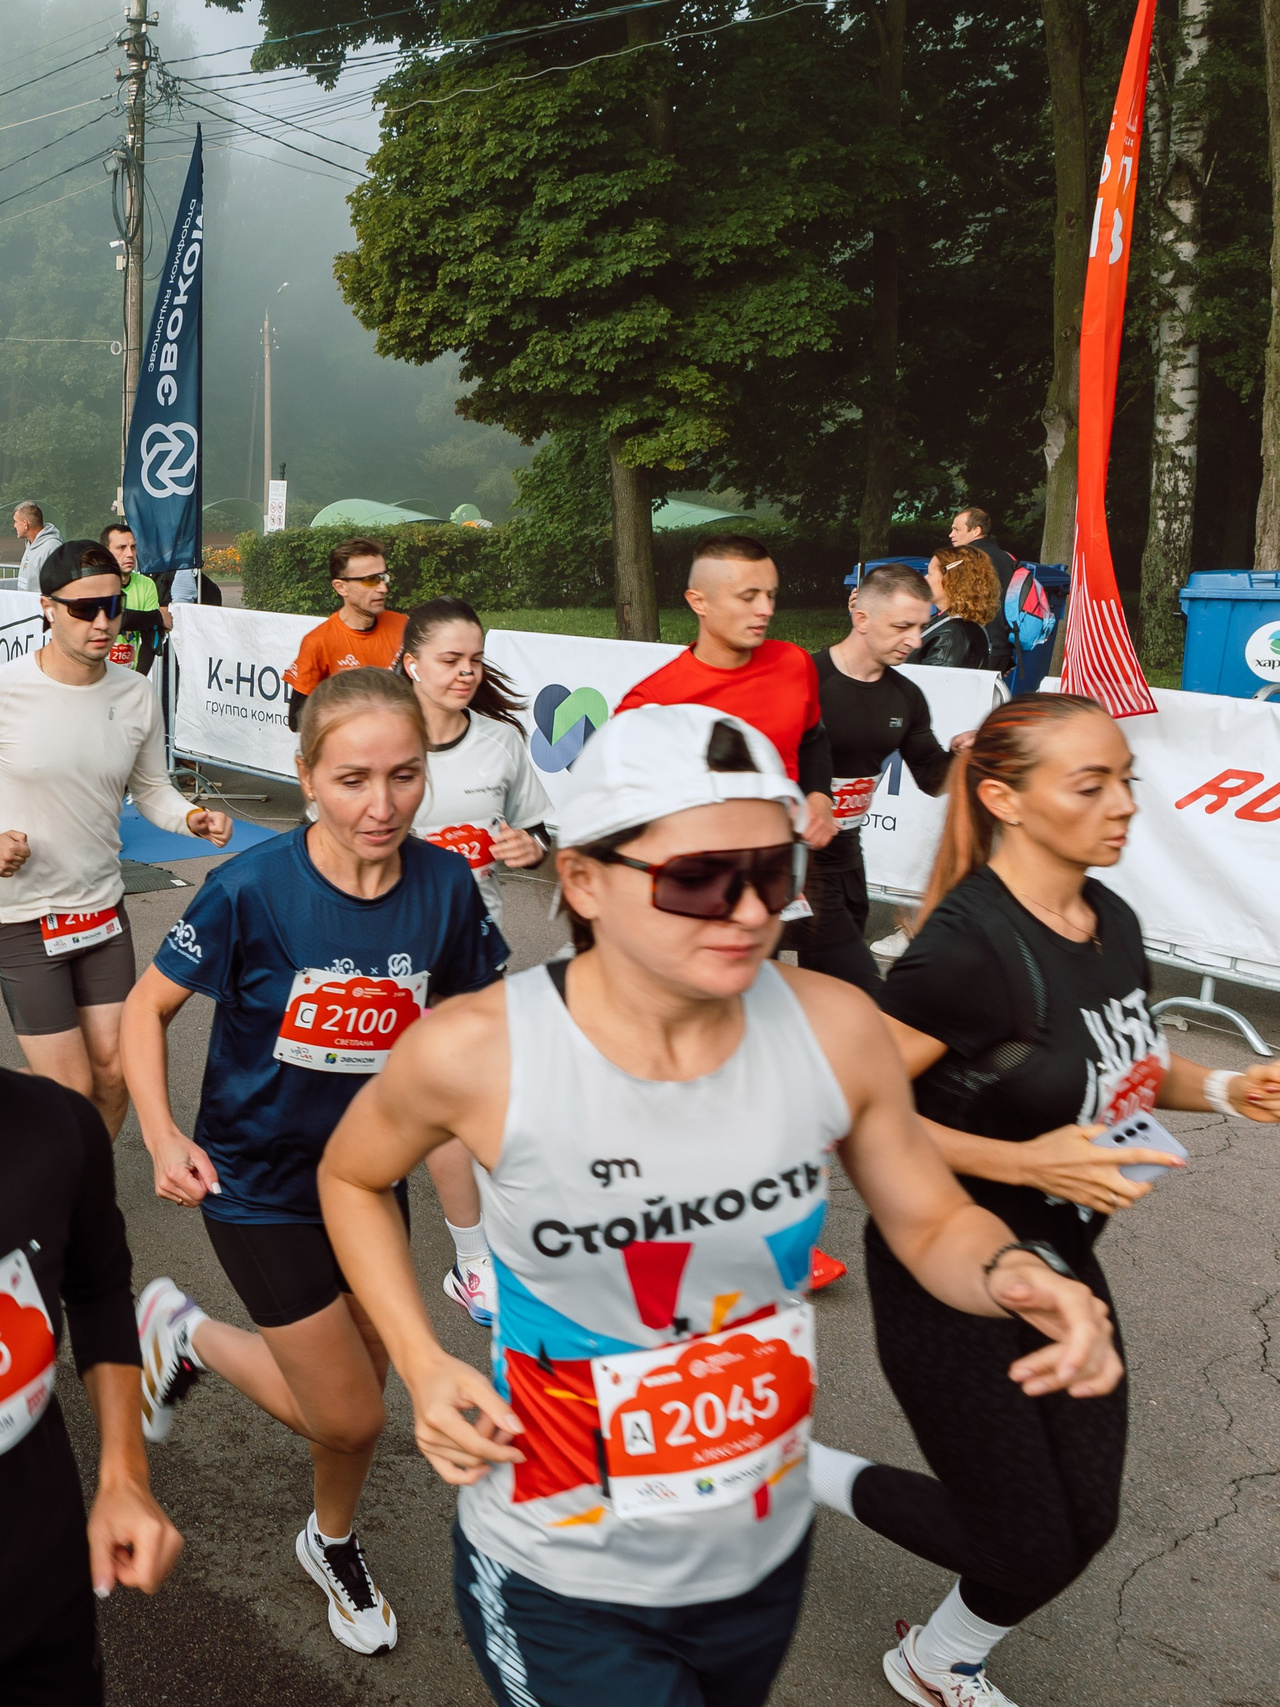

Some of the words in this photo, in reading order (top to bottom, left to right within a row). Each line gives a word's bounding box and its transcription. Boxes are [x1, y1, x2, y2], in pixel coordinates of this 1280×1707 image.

[205, 700, 248, 719] группа
[321, 1004, 398, 1034] 2100
[660, 1371, 780, 1447] 2045
